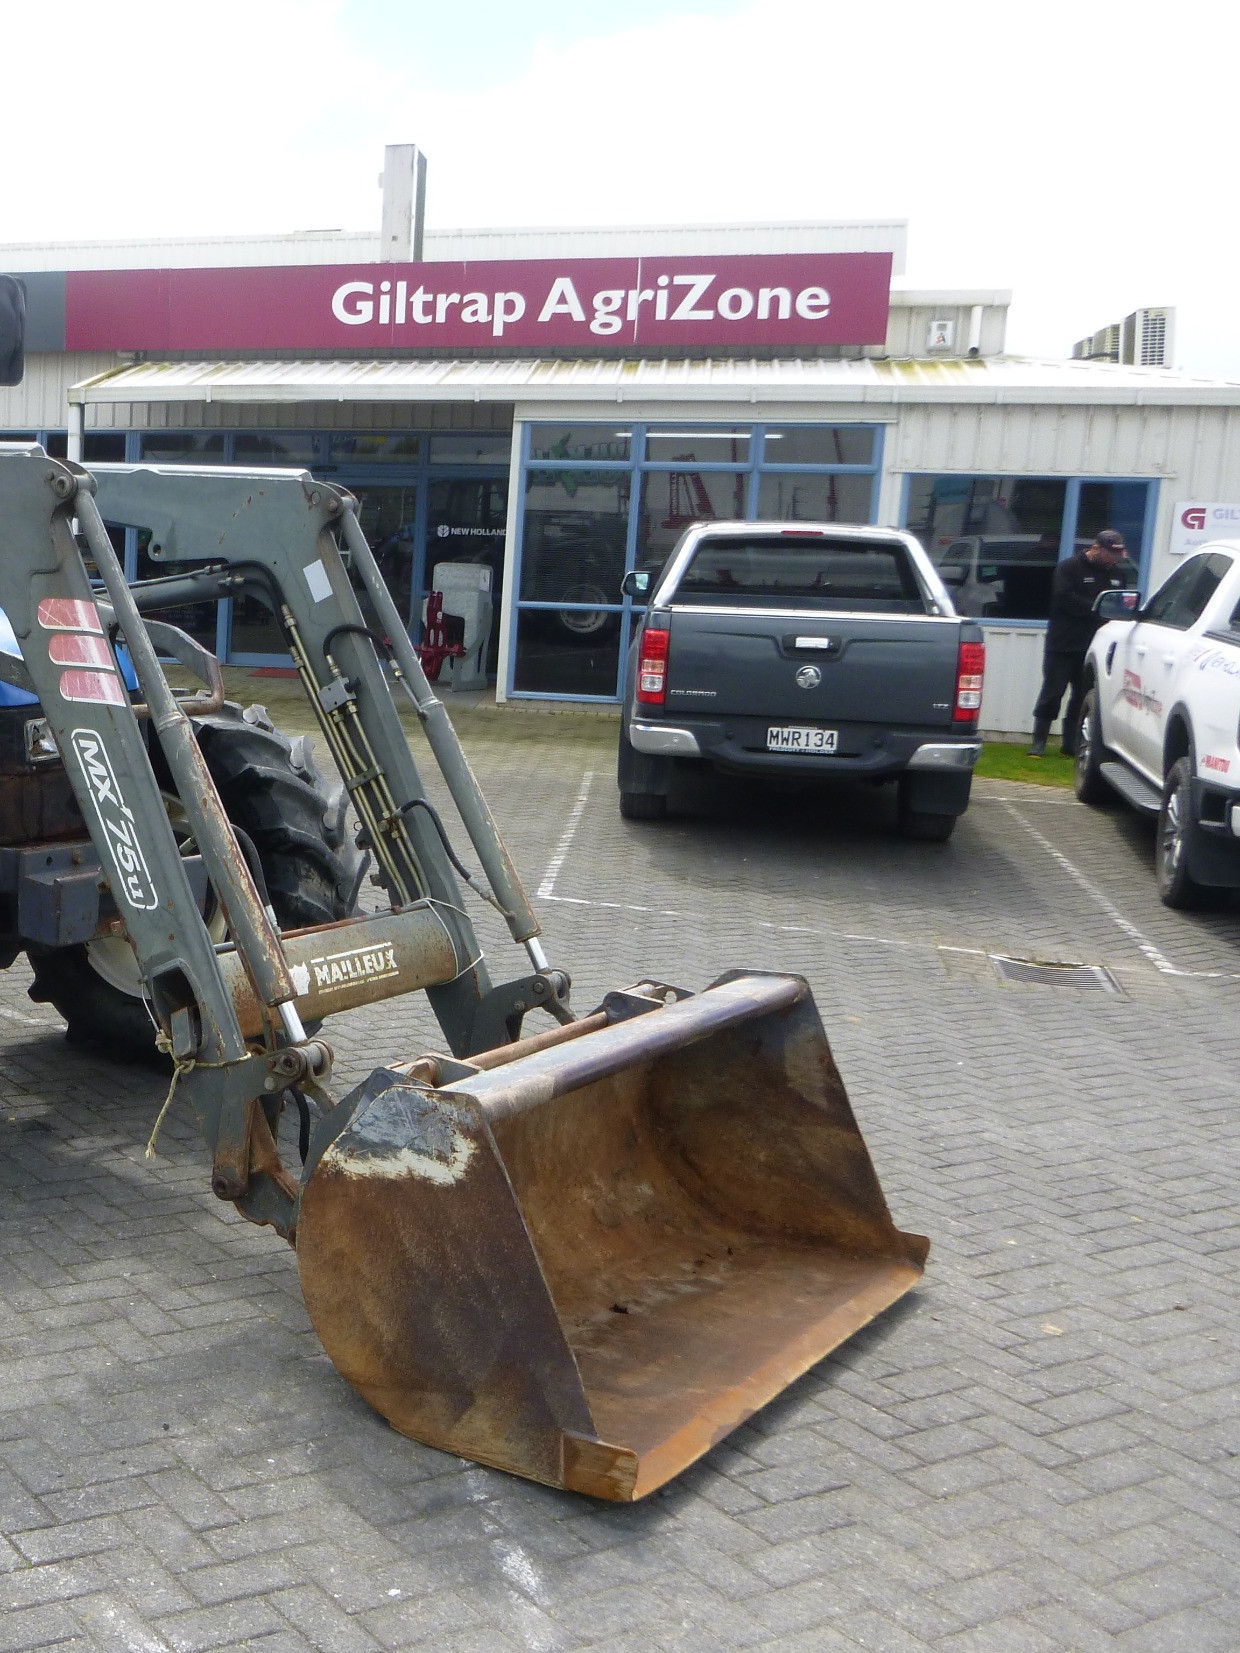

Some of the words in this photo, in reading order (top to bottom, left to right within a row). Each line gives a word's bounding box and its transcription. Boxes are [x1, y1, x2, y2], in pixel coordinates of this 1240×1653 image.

[331, 280, 526, 337] Giltrap
[537, 274, 831, 335] AgriZone
[1212, 508, 1240, 521] GIL
[450, 527, 469, 535] NEW
[470, 528, 507, 536] HOLLAND
[768, 729, 835, 749] MWR134
[78, 739, 119, 807] MX
[313, 948, 398, 987] MAILLEUX
